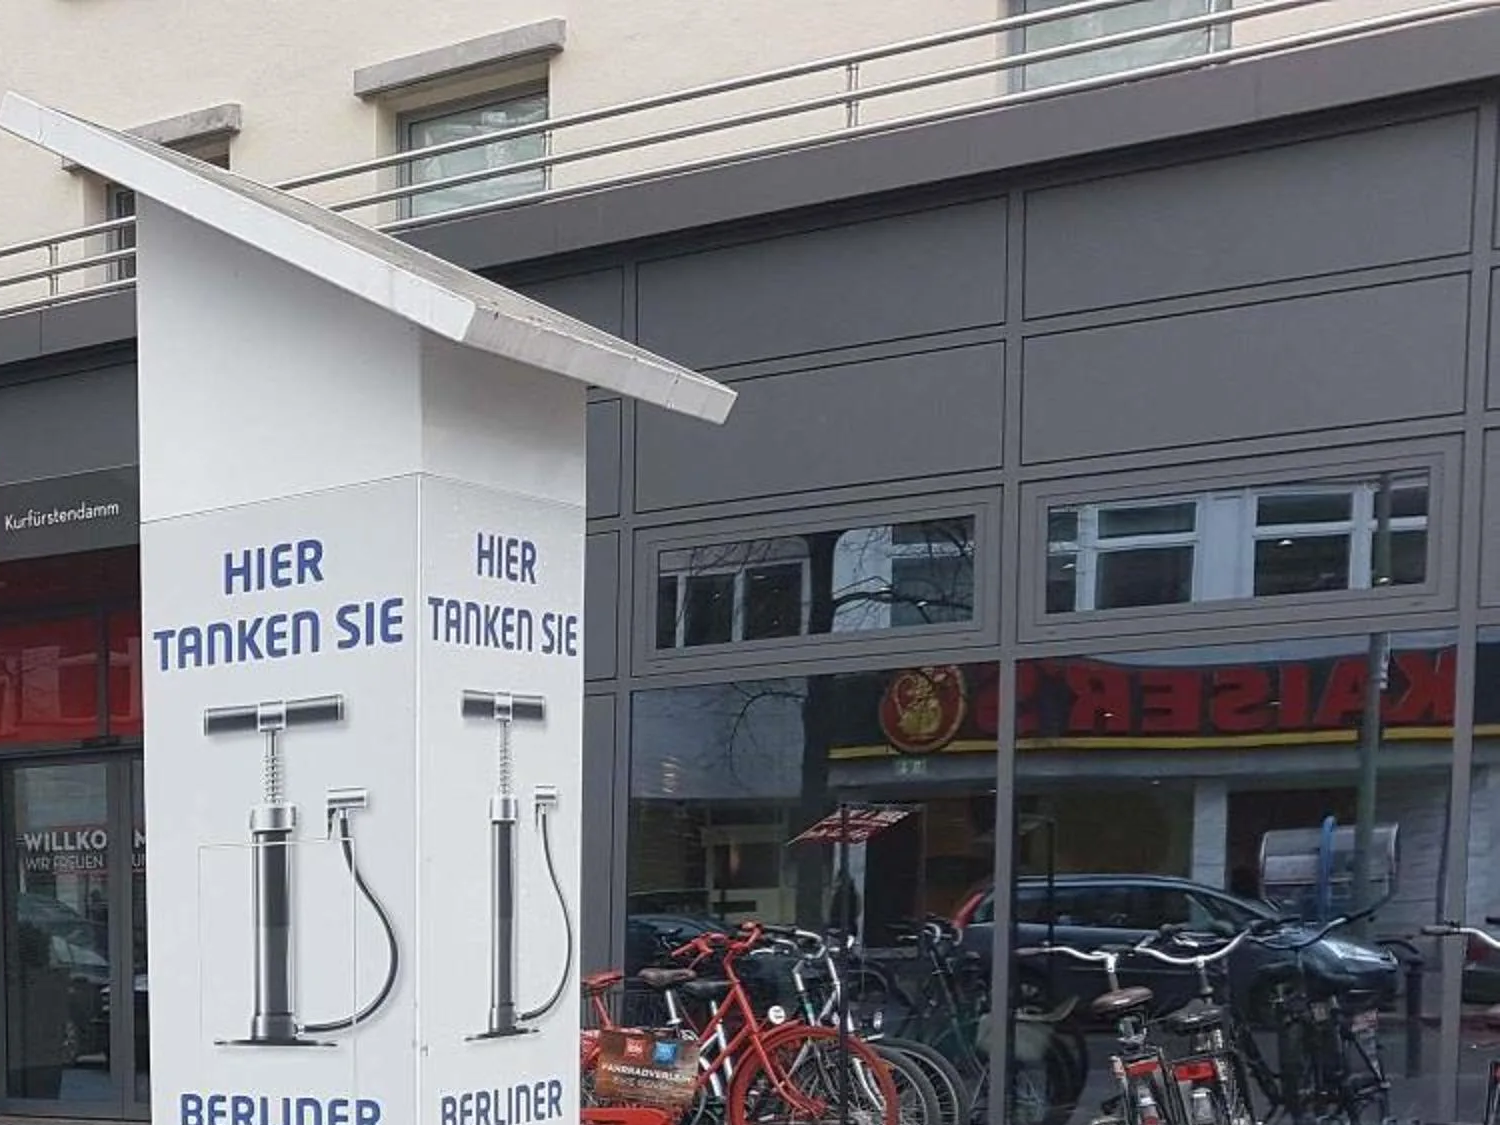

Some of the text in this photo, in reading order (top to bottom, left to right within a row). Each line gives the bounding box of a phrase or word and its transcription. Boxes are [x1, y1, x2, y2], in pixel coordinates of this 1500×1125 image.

[4, 501, 120, 531] Kurfürstendamm
[224, 539, 324, 595] HIER
[477, 532, 537, 585] HIER
[153, 597, 404, 671] TANKEN SIE
[427, 596, 577, 657] TANKEN SIE
